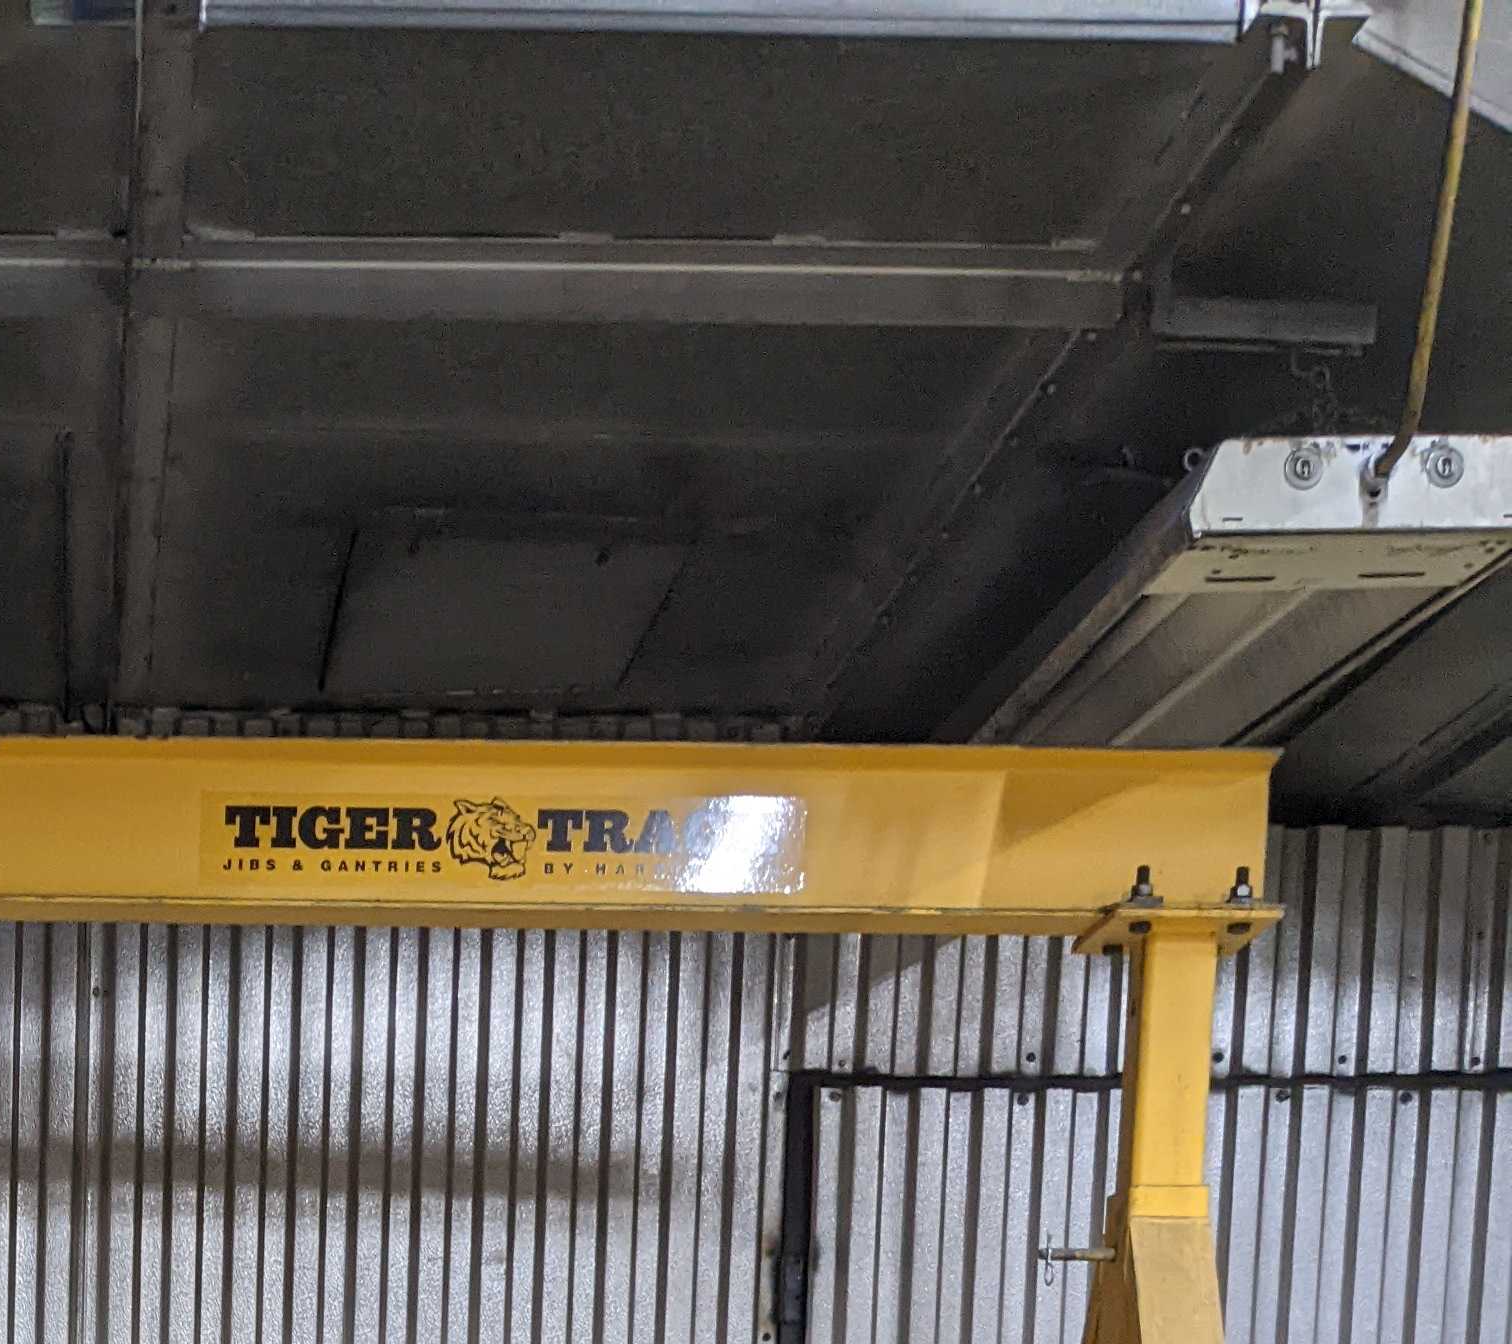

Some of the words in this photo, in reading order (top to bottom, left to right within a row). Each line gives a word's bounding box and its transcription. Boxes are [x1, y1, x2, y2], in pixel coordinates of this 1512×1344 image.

[225, 805, 442, 851] TIGER
[223, 859, 276, 871] JIBS
[292, 859, 303, 871] &
[320, 860, 441, 874] GANTRIES
